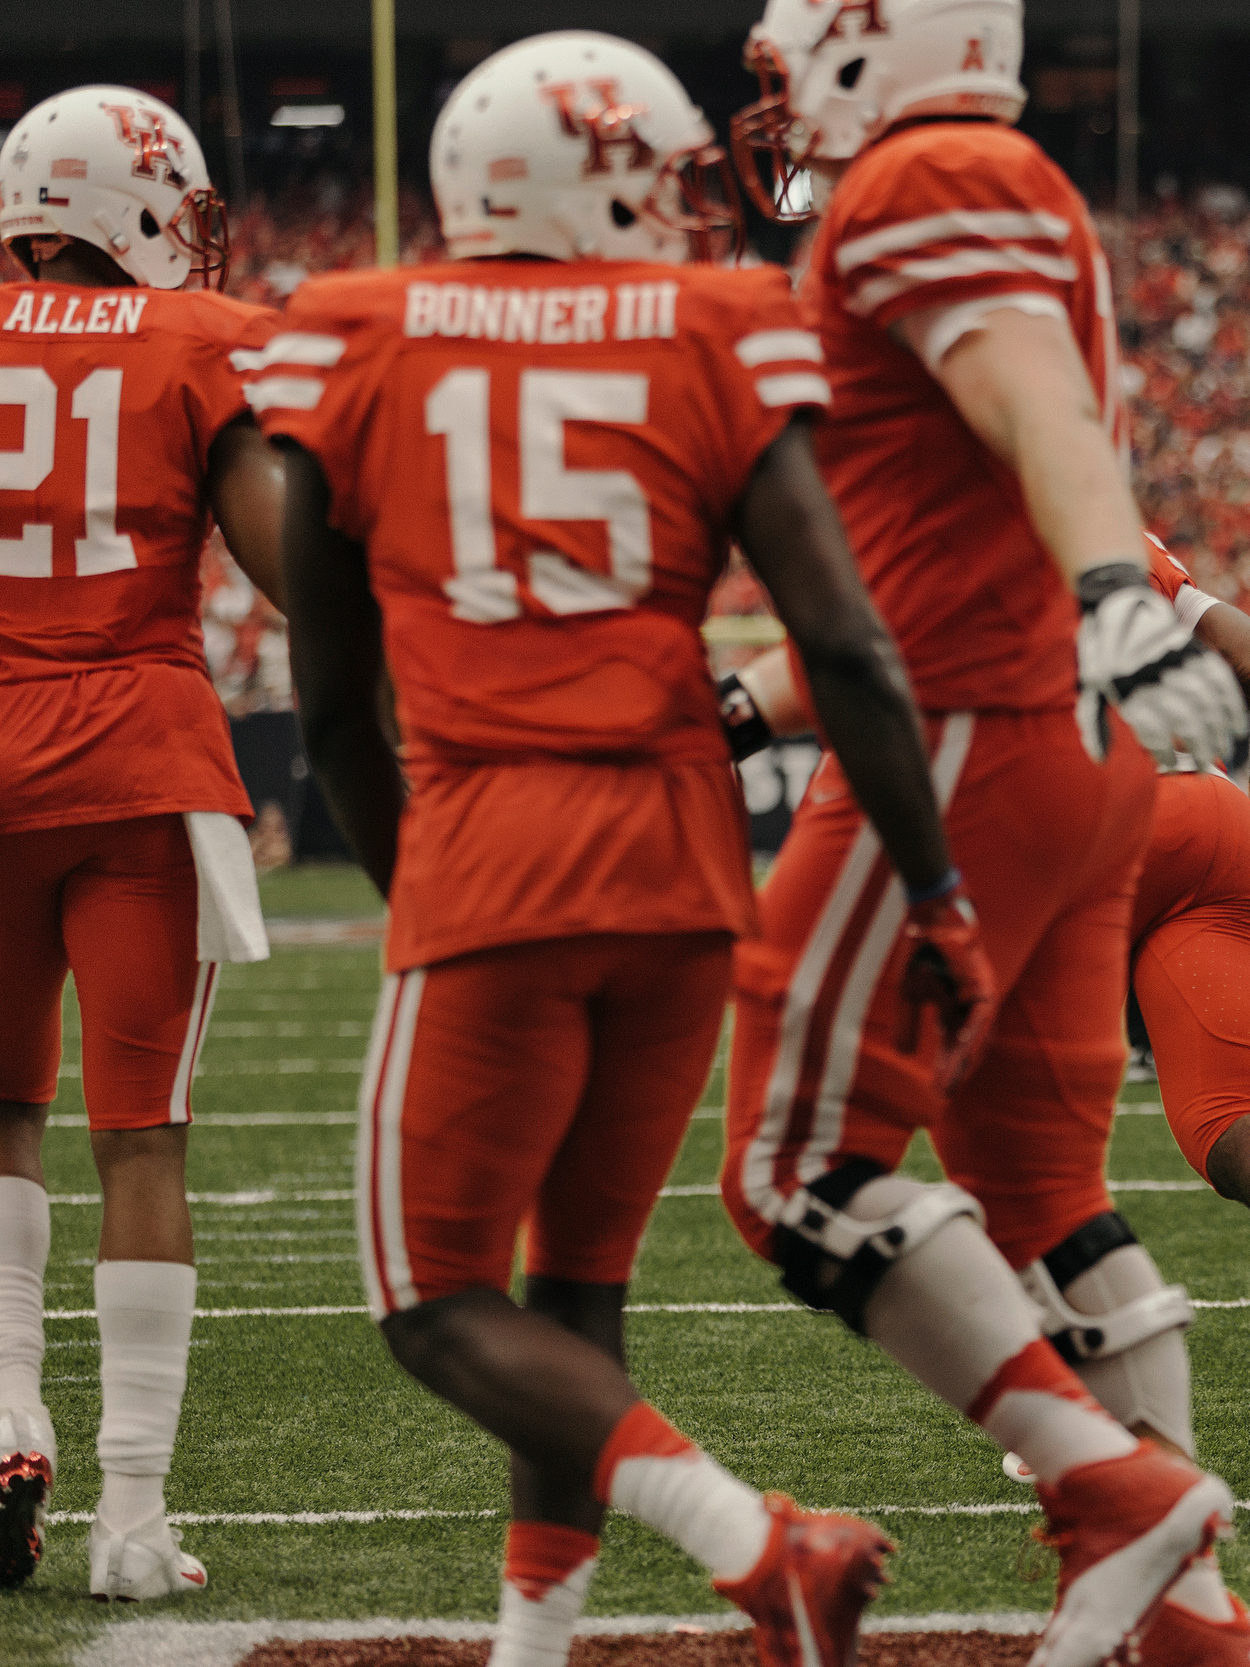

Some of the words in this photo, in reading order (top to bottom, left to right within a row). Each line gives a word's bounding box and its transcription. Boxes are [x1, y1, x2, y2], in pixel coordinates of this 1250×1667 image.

[2, 291, 148, 334] ALLEN
[404, 281, 609, 344] BONNER
[614, 279, 680, 341] III
[0, 366, 138, 578] 21
[424, 365, 654, 625] 15
